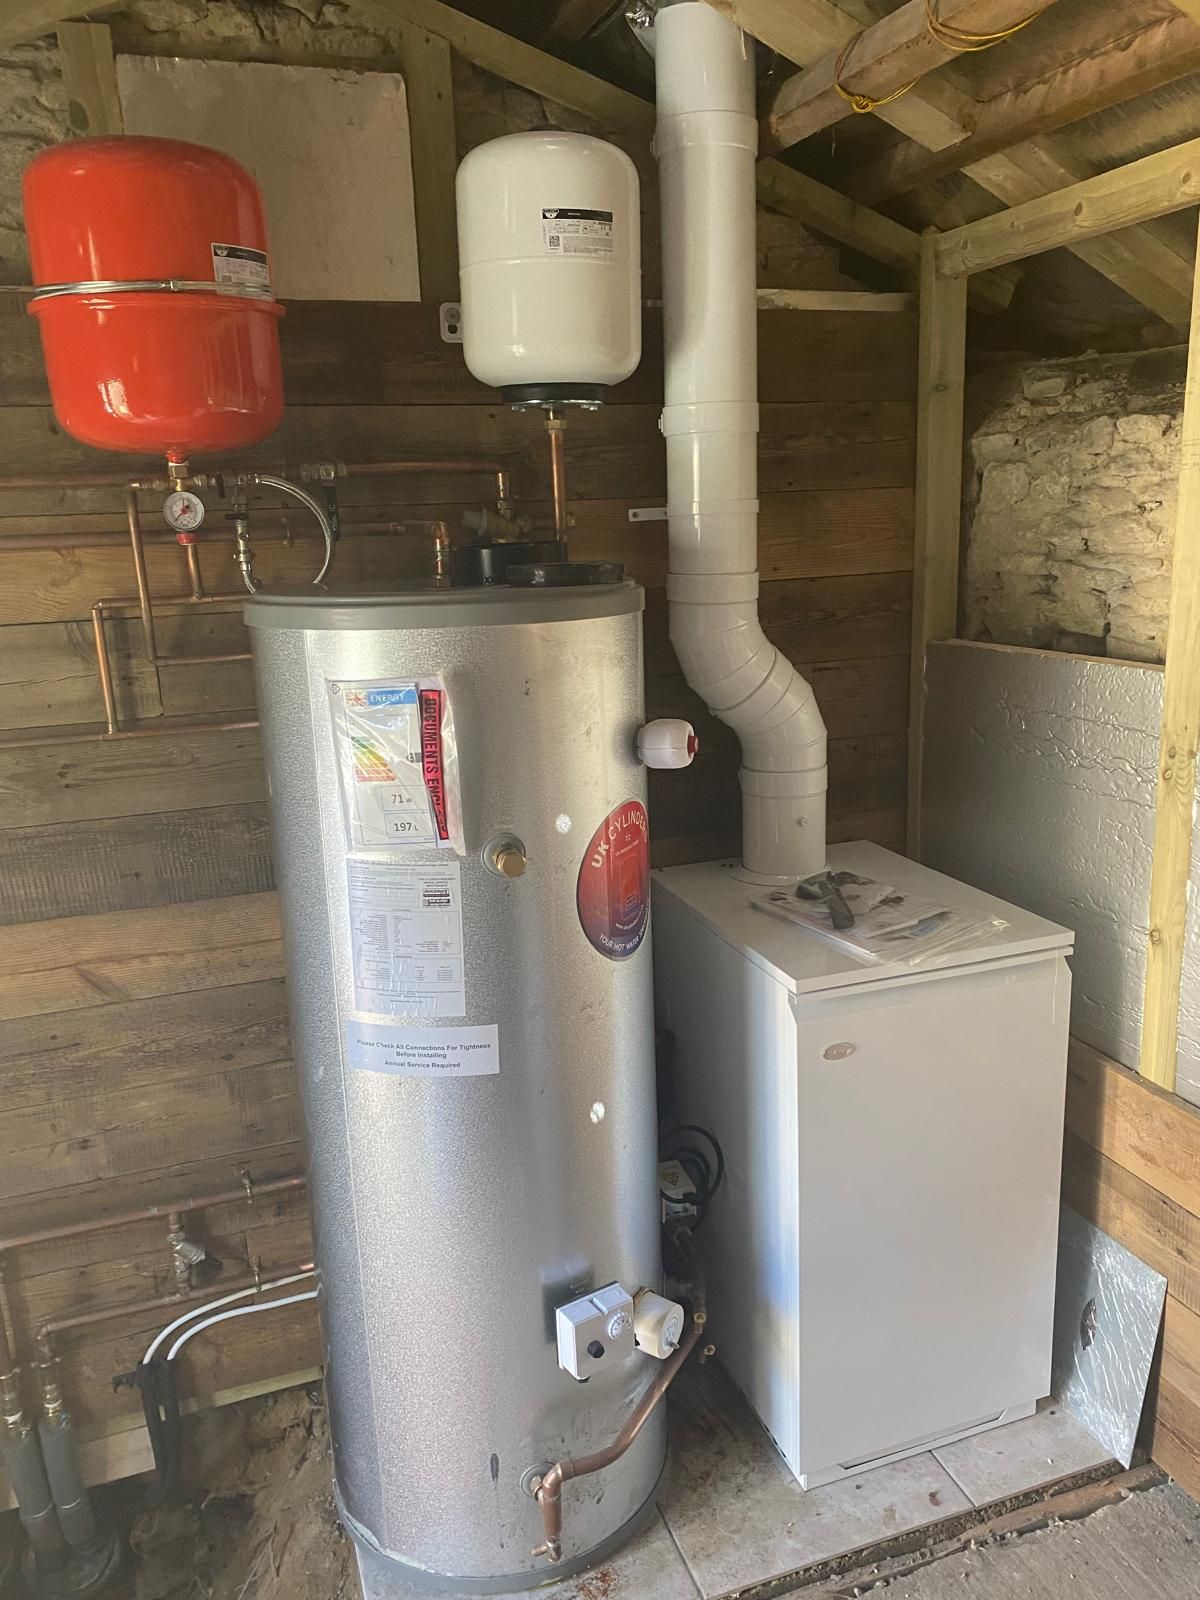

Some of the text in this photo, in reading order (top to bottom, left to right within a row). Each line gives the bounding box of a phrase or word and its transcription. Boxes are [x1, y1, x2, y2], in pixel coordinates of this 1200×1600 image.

[424, 698, 438, 773] DOCUMENTS
[391, 794, 404, 803] 71
[393, 822, 412, 832] 197
[591, 839, 609, 868] UK
[614, 943, 625, 952] HOT
[356, 1039, 375, 1047] Please
[376, 1041, 394, 1049] Check
[459, 1043, 491, 1051] Tightness
